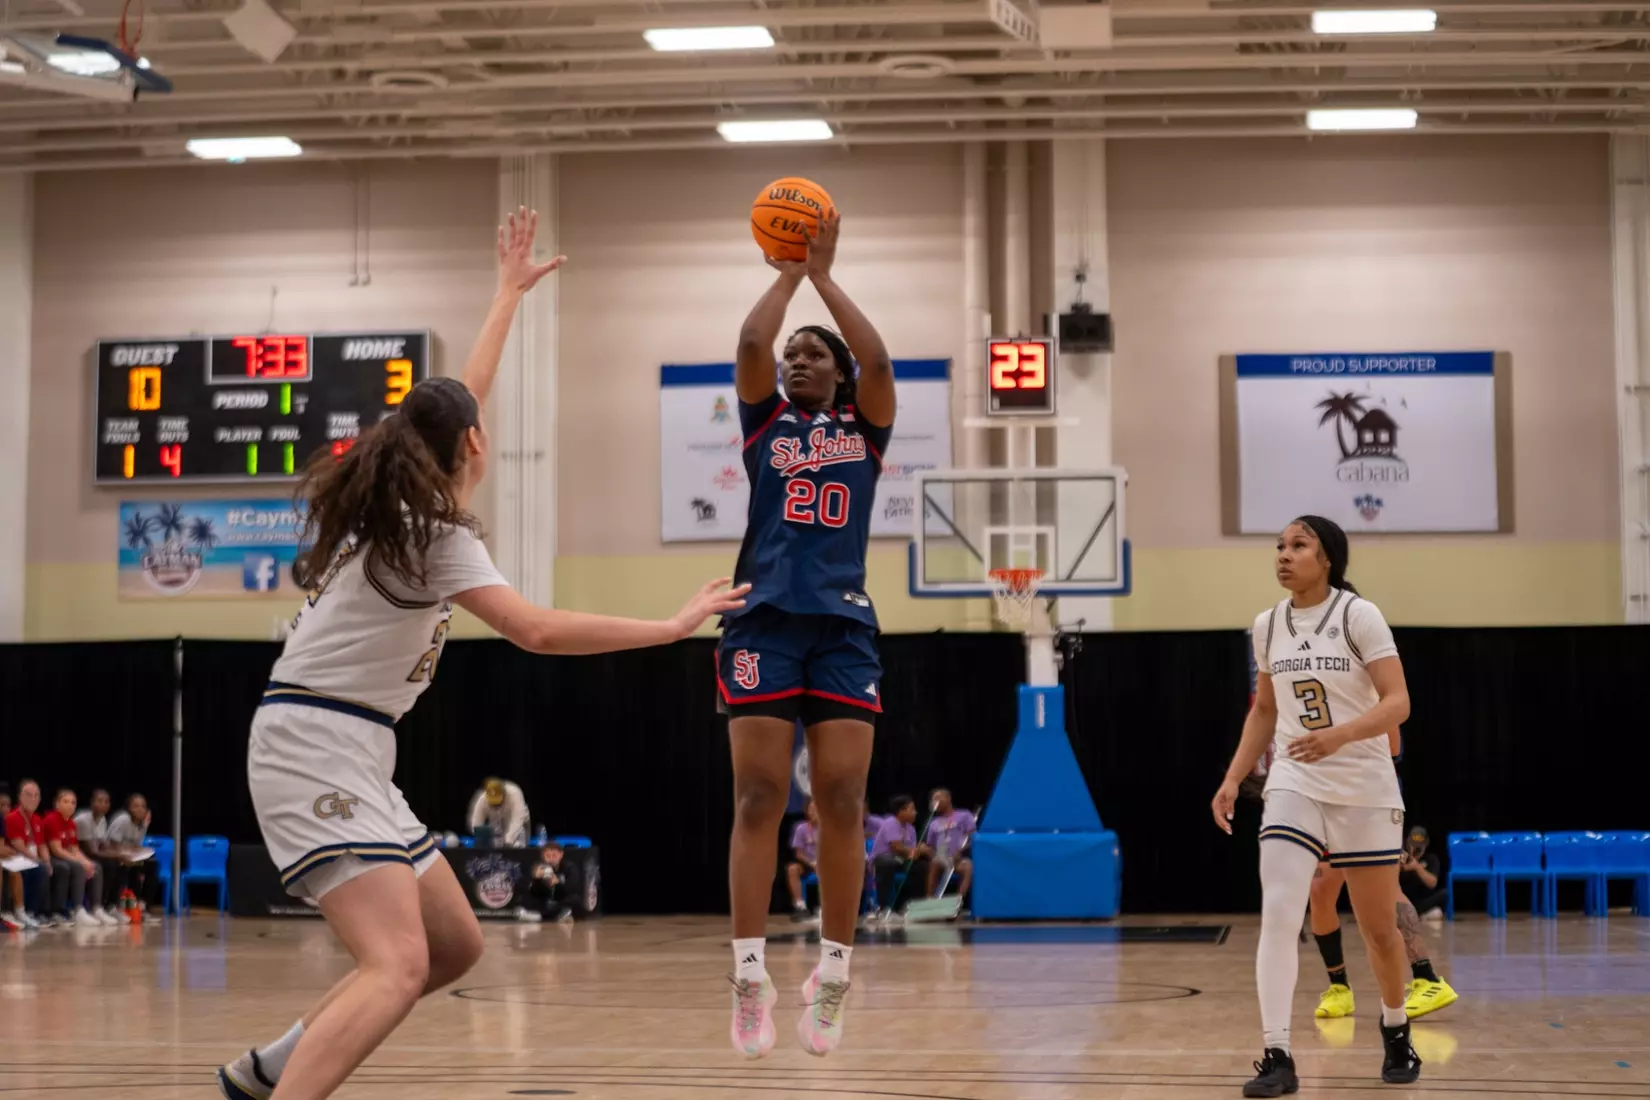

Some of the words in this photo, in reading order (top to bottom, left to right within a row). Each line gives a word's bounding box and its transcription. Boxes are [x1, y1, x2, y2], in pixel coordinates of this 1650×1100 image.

[112, 345, 179, 366] GUEST
[232, 336, 308, 378] 7:33
[344, 339, 406, 360] HOME
[991, 342, 1046, 390] 23
[1292, 358, 1345, 373] PROUD
[1348, 356, 1437, 373] SUPPORTER
[384, 358, 413, 405] 3
[213, 391, 268, 408] PERIOD
[279, 382, 291, 416] 1
[158, 417, 189, 430] TIME
[329, 414, 359, 426] TIME
[157, 430, 189, 443] OUTS
[216, 428, 262, 442] PLAYER
[269, 428, 300, 441] FOUL
[327, 427, 359, 439] OUTS
[123, 443, 135, 479] 1
[159, 443, 182, 478] 4
[246, 442, 258, 476] 1
[283, 442, 295, 476] 1
[770, 437, 806, 469] St.
[1336, 461, 1410, 482] cabana
[784, 478, 851, 528] 20
[1316, 656, 1350, 672] TECH
[1292, 678, 1333, 731] 3
[313, 791, 359, 820] GT
